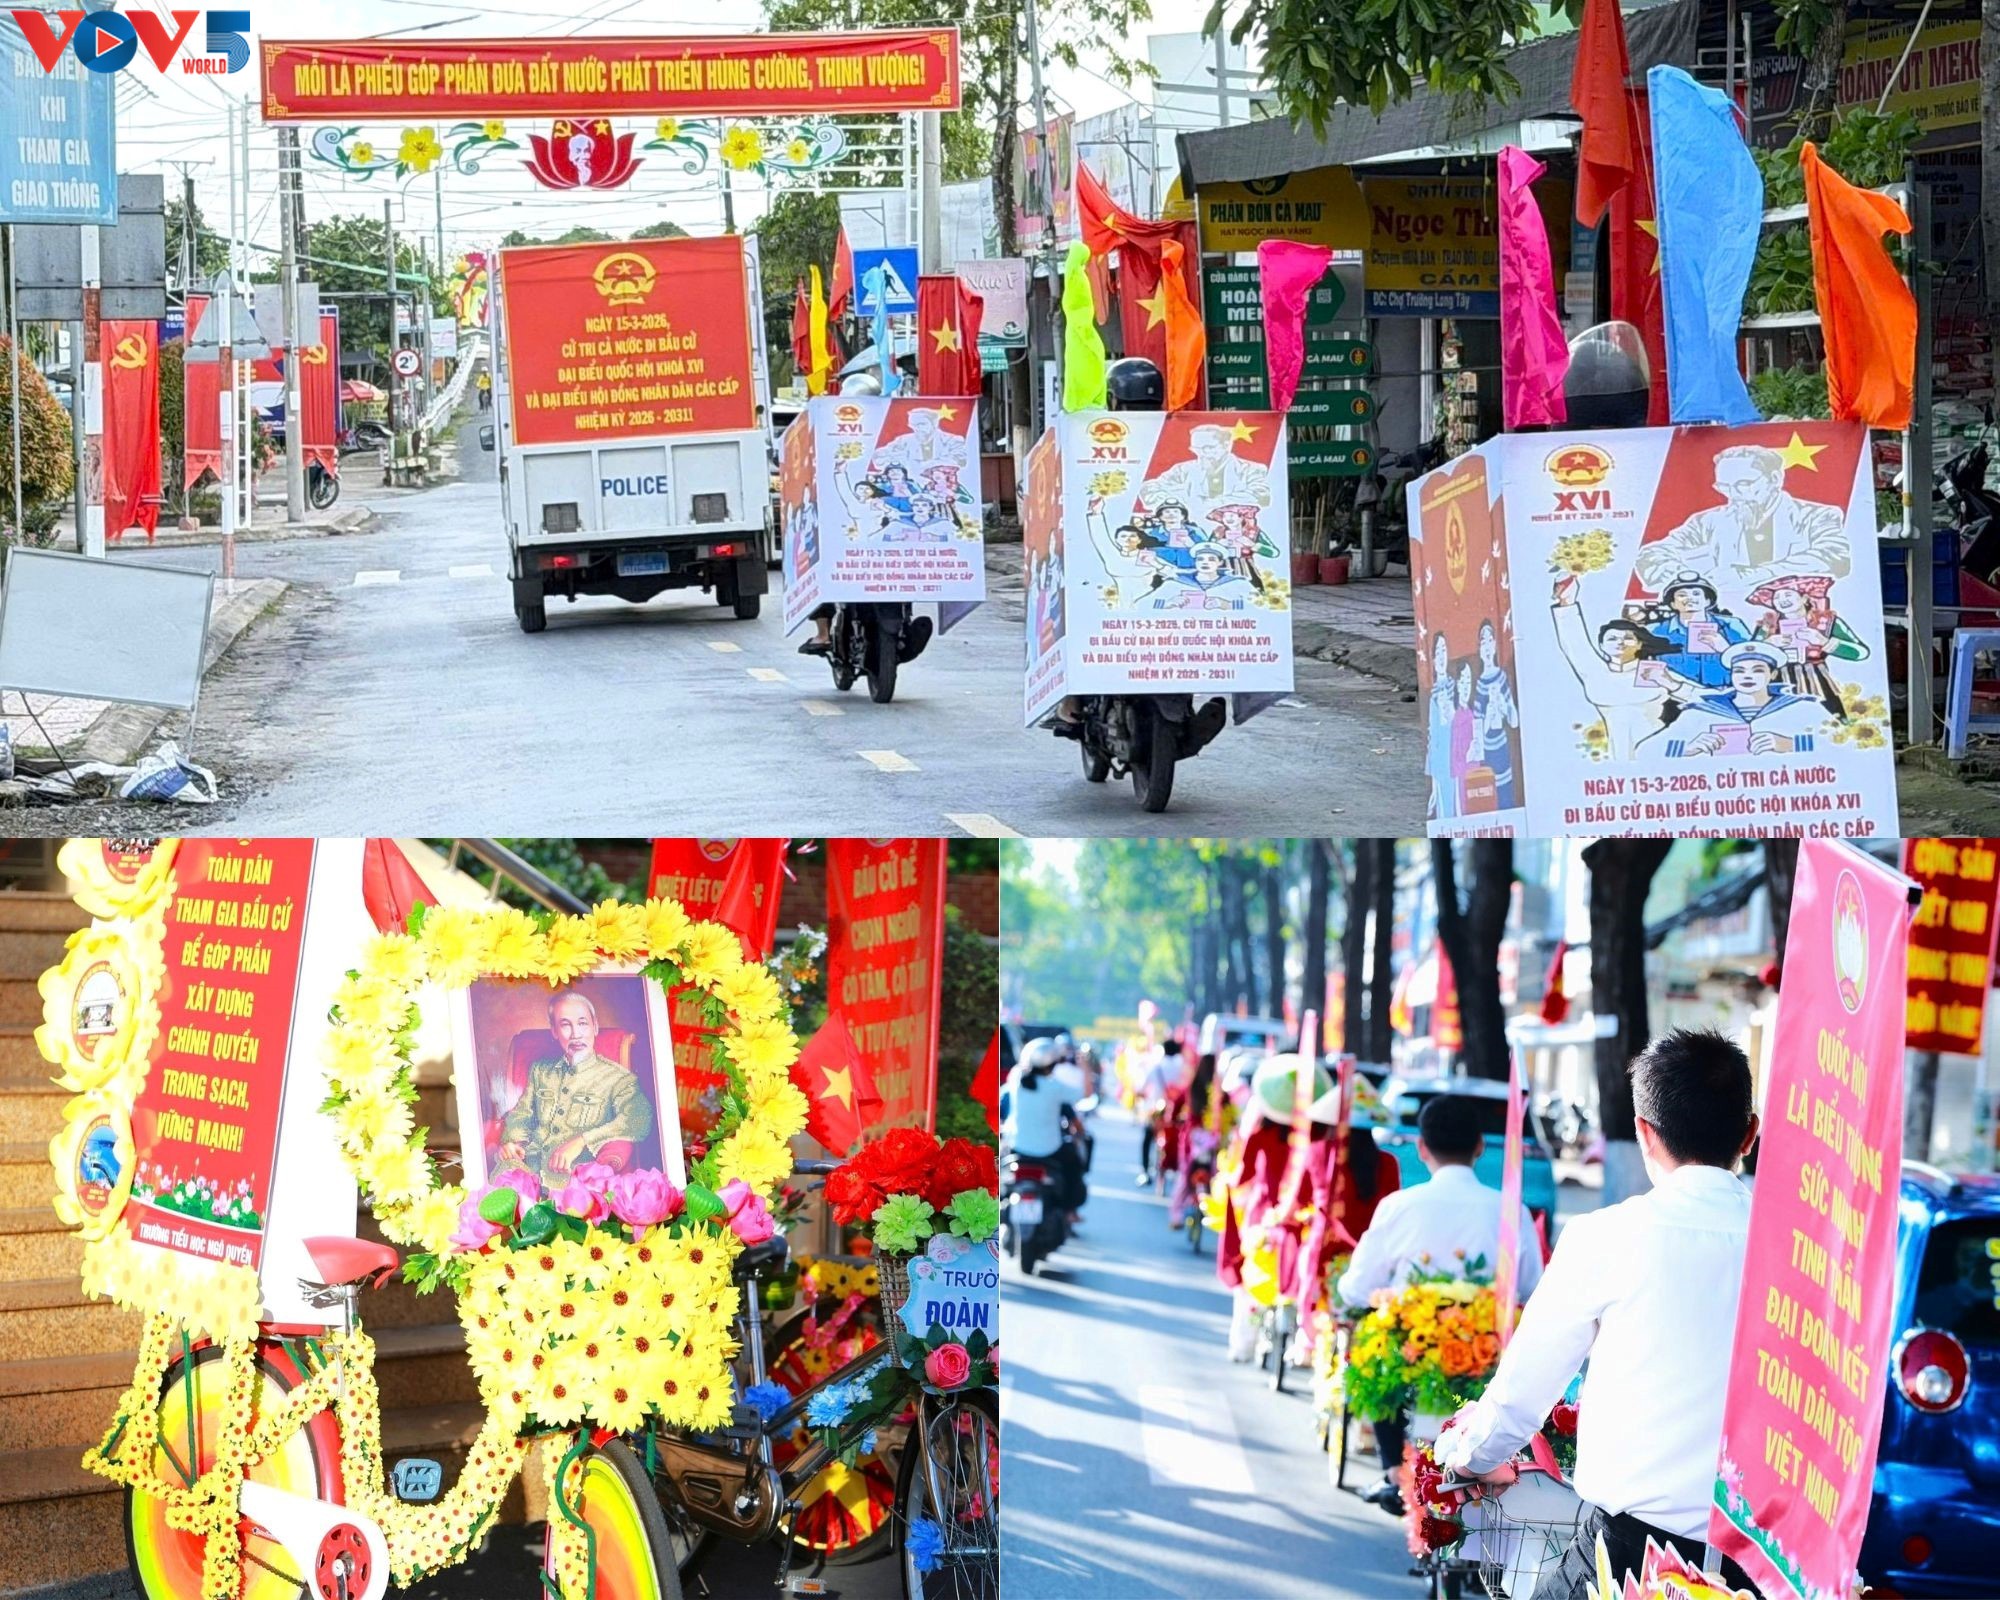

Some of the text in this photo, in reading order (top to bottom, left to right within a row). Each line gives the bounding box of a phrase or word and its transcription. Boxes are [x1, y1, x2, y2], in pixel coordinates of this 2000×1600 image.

[294, 49, 926, 96] MỖI LÁ PHIẾU GÓP PHẦN ĐƯA ĐẤT NƯỚC PHÁT TRIỂN HÙNG CƯỜNG, THỊNH VƯỢNG!
[40, 96, 66, 122] KHI
[18, 137, 90, 166] THAM GIA
[12, 176, 100, 208] GIAO THÔNG
[1210, 198, 1321, 223] PHÂN BÓN CÀ MAU
[1372, 205, 1444, 243] Ngọc
[585, 313, 670, 333] NGÀY 15-3-2026,
[578, 342, 596, 357] TRI
[615, 337, 643, 355] NƯỚC
[1228, 355, 1251, 363] MAU
[1321, 354, 1344, 363] MAU
[558, 367, 576, 385] ĐẠI
[578, 358, 603, 381] BIỂU
[605, 358, 633, 382] QUỐC
[636, 359, 654, 379] HỘI
[687, 358, 704, 374] XVI
[525, 376, 739, 410] VÀ ĐẠI BIỂU HỘI ĐỒNG NHÂN DÂN CÁC CẤP
[1312, 404, 1329, 412] BIO
[575, 411, 609, 431] NHIỆM
[628, 410, 654, 426] 2026
[837, 423, 863, 432] XVI
[1091, 447, 1127, 458] XVI
[1323, 455, 1345, 464] MAU
[600, 475, 668, 497] POLICE
[1553, 490, 1611, 511] XVI
[1584, 765, 1836, 797] NGÀY 15-3-2026, CỬ TRI CẢ NƯỚC
[1564, 792, 1861, 824] ĐI BẦU CỬ ĐẠI BIỂU QUỐC HỘI KHÓA XVI
[1809, 819, 1839, 838] CÁC
[1845, 816, 1875, 838] CẤP
[207, 856, 273, 885] TOÀN DÂN
[176, 897, 293, 932] THAM GIA BẦU CỬ
[182, 940, 271, 975] ĐỂ GÓP PHẦN
[185, 983, 254, 1020] XÂY DỰNG
[167, 1024, 259, 1064] CHÍNH QUYỀN
[1817, 1028, 1868, 1109] QUỐC HỘI
[163, 1069, 249, 1112] TRONG SẠCH,
[156, 1109, 244, 1155] VỮNG MẠNH!
[1786, 1079, 1808, 1130] LÀ
[1813, 1090, 1845, 1155] BIỂU
[1799, 1160, 1829, 1216] SỨC
[140, 1223, 170, 1244] TRƯỜNG
[172, 1227, 189, 1249] TIỂU
[189, 1235, 206, 1255] HỌC
[207, 1239, 225, 1258] NGÔ
[1792, 1228, 1828, 1289] TINH
[925, 1296, 989, 1329] ĐOÀN
[1765, 1285, 1870, 1403] ĐẠI ĐOÀN KẾT
[1757, 1348, 1863, 1476] TOÀN DÂN TỘC
[1764, 1425, 1840, 1529] VIỆT NAM!
